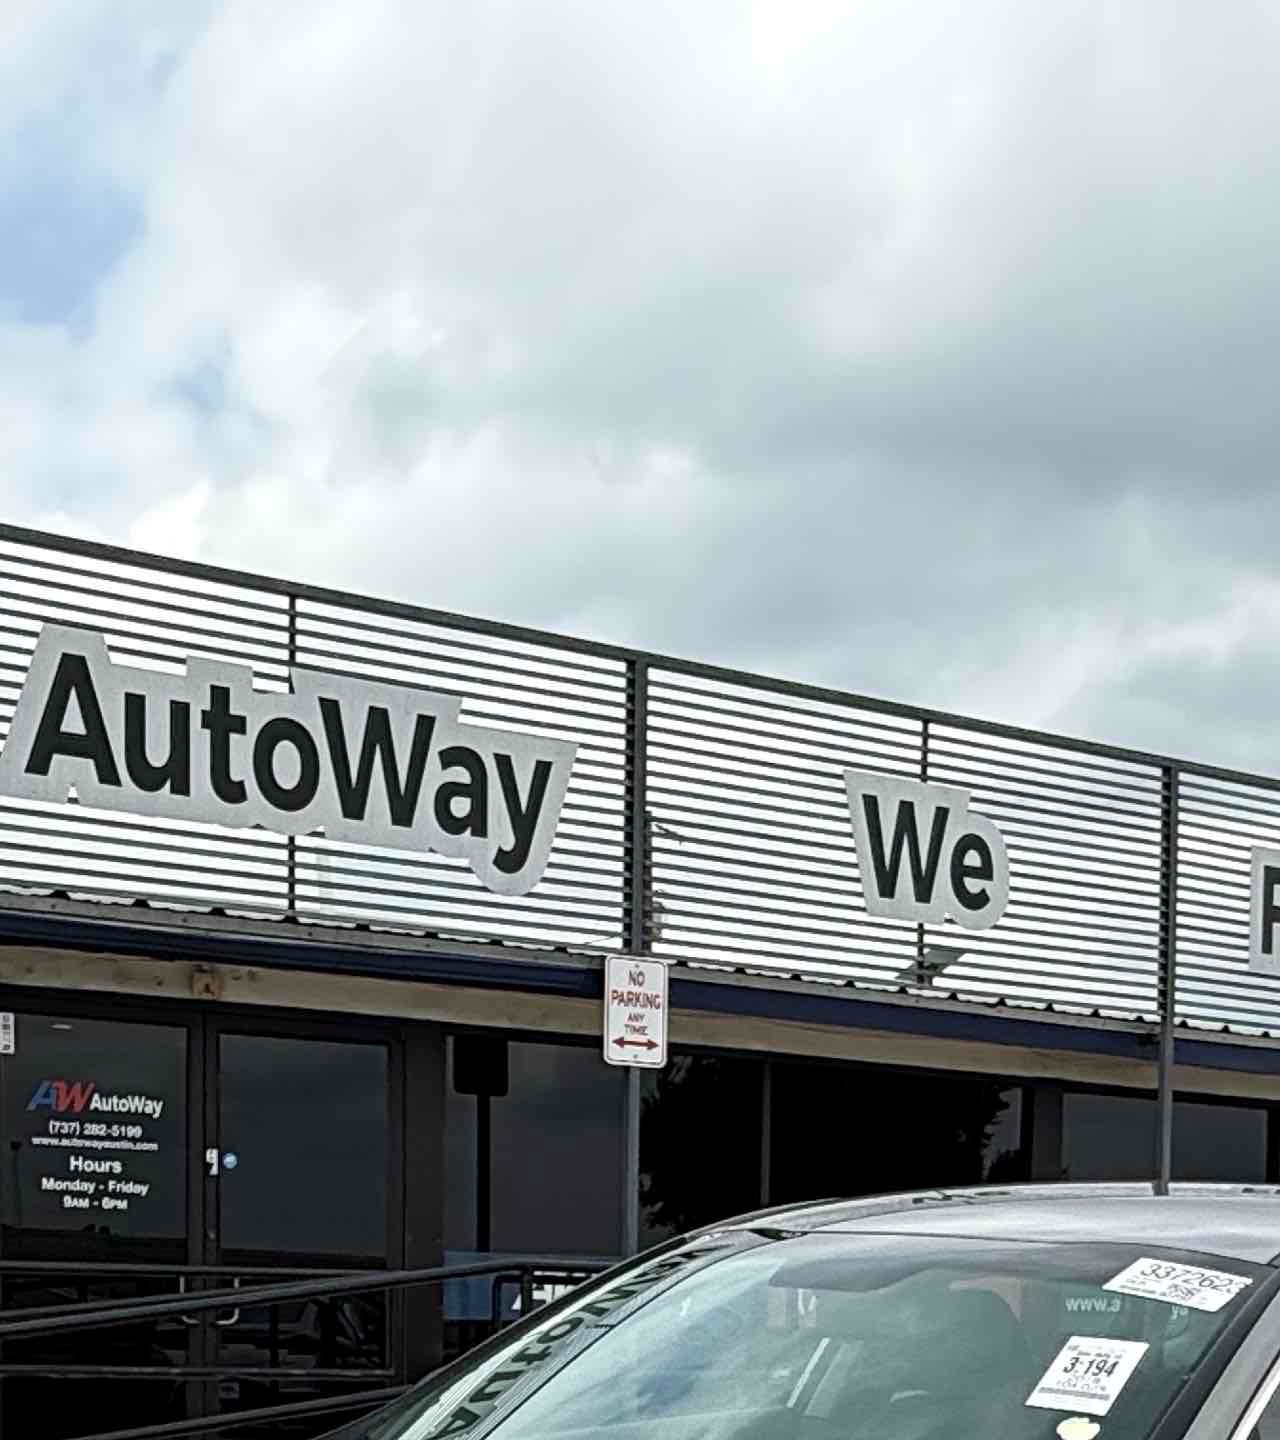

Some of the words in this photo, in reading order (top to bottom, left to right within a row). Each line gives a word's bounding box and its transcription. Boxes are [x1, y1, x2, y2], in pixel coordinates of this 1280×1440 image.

[24, 651, 554, 875] AutoWay
[861, 793, 994, 912] We
[628, 970, 646, 987] NO
[610, 989, 661, 1010] PARKING
[627, 1013, 646, 1022] ANY
[624, 1023, 648, 1036] TIME
[89, 1092, 164, 1119] AutoWay
[48, 1119, 80, 1136] (737)
[69, 1155, 123, 1174] Hours
[41, 1176, 96, 1195] Monday
[108, 1180, 150, 1197] Friday
